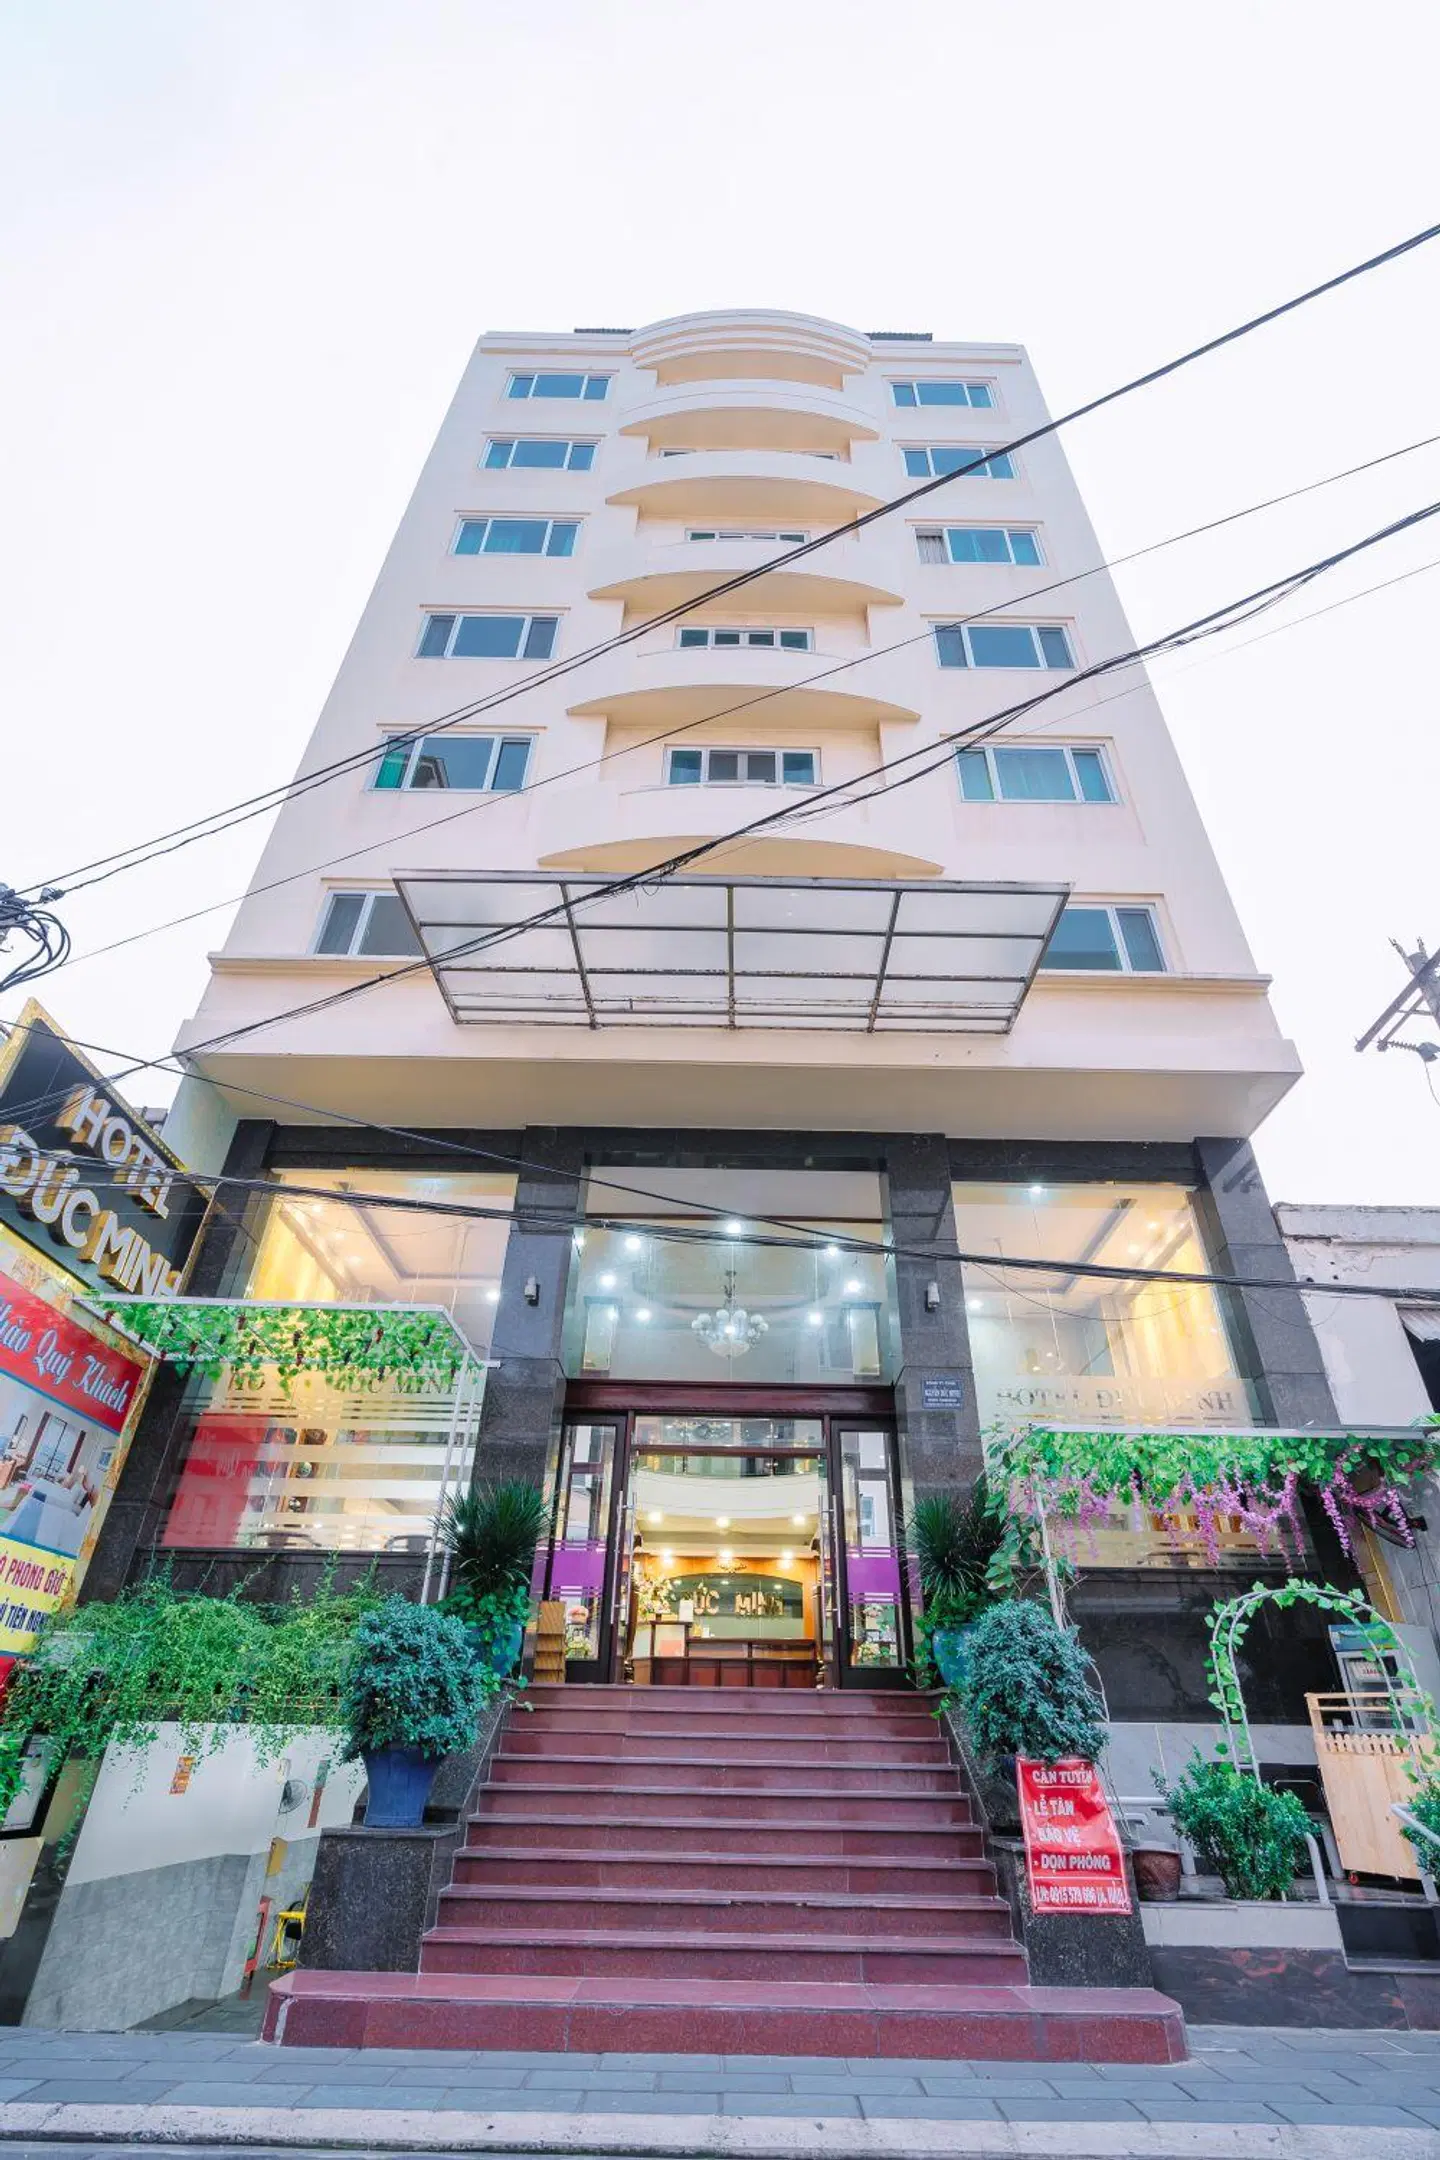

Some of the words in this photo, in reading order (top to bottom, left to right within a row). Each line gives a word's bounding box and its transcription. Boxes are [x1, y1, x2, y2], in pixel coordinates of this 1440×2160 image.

[60, 1083, 170, 1220] HOTEL
[82, 1210, 181, 1296] MINH
[1041, 1854, 1066, 1873] DỌN
[1069, 1851, 1112, 1871] PHÒNG
